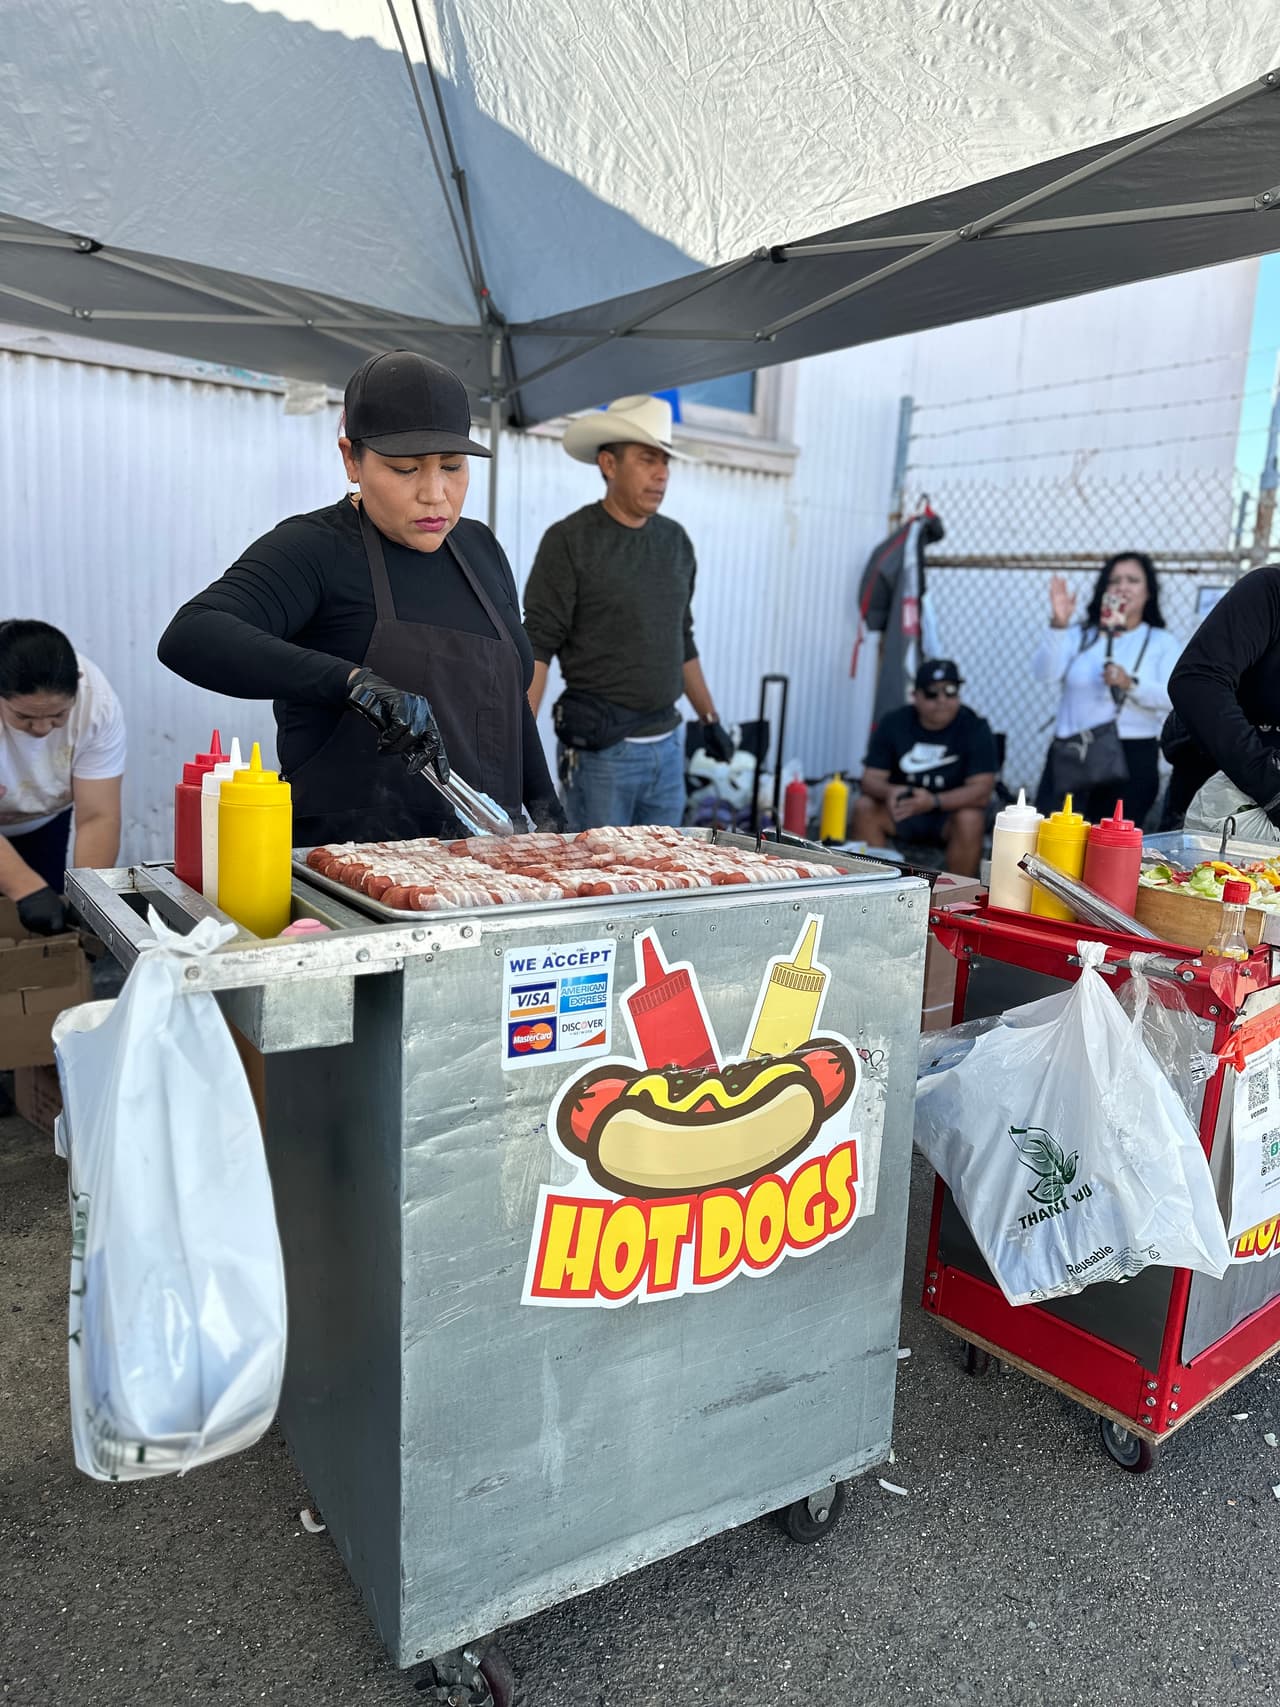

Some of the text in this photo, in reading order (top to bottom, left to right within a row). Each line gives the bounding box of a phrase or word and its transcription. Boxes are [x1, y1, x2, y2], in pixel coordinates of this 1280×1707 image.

[509, 950, 611, 973] WE ACCEPT
[561, 983, 605, 996] AMERICAN
[518, 992, 550, 1007] VISA
[570, 993, 607, 1006] EXPRESS
[562, 1019, 603, 1032] DISCOVER
[513, 1031, 552, 1044] MasterCard
[533, 1142, 858, 1299] HOT DOGS
[1066, 1246, 1114, 1277] Reusable
